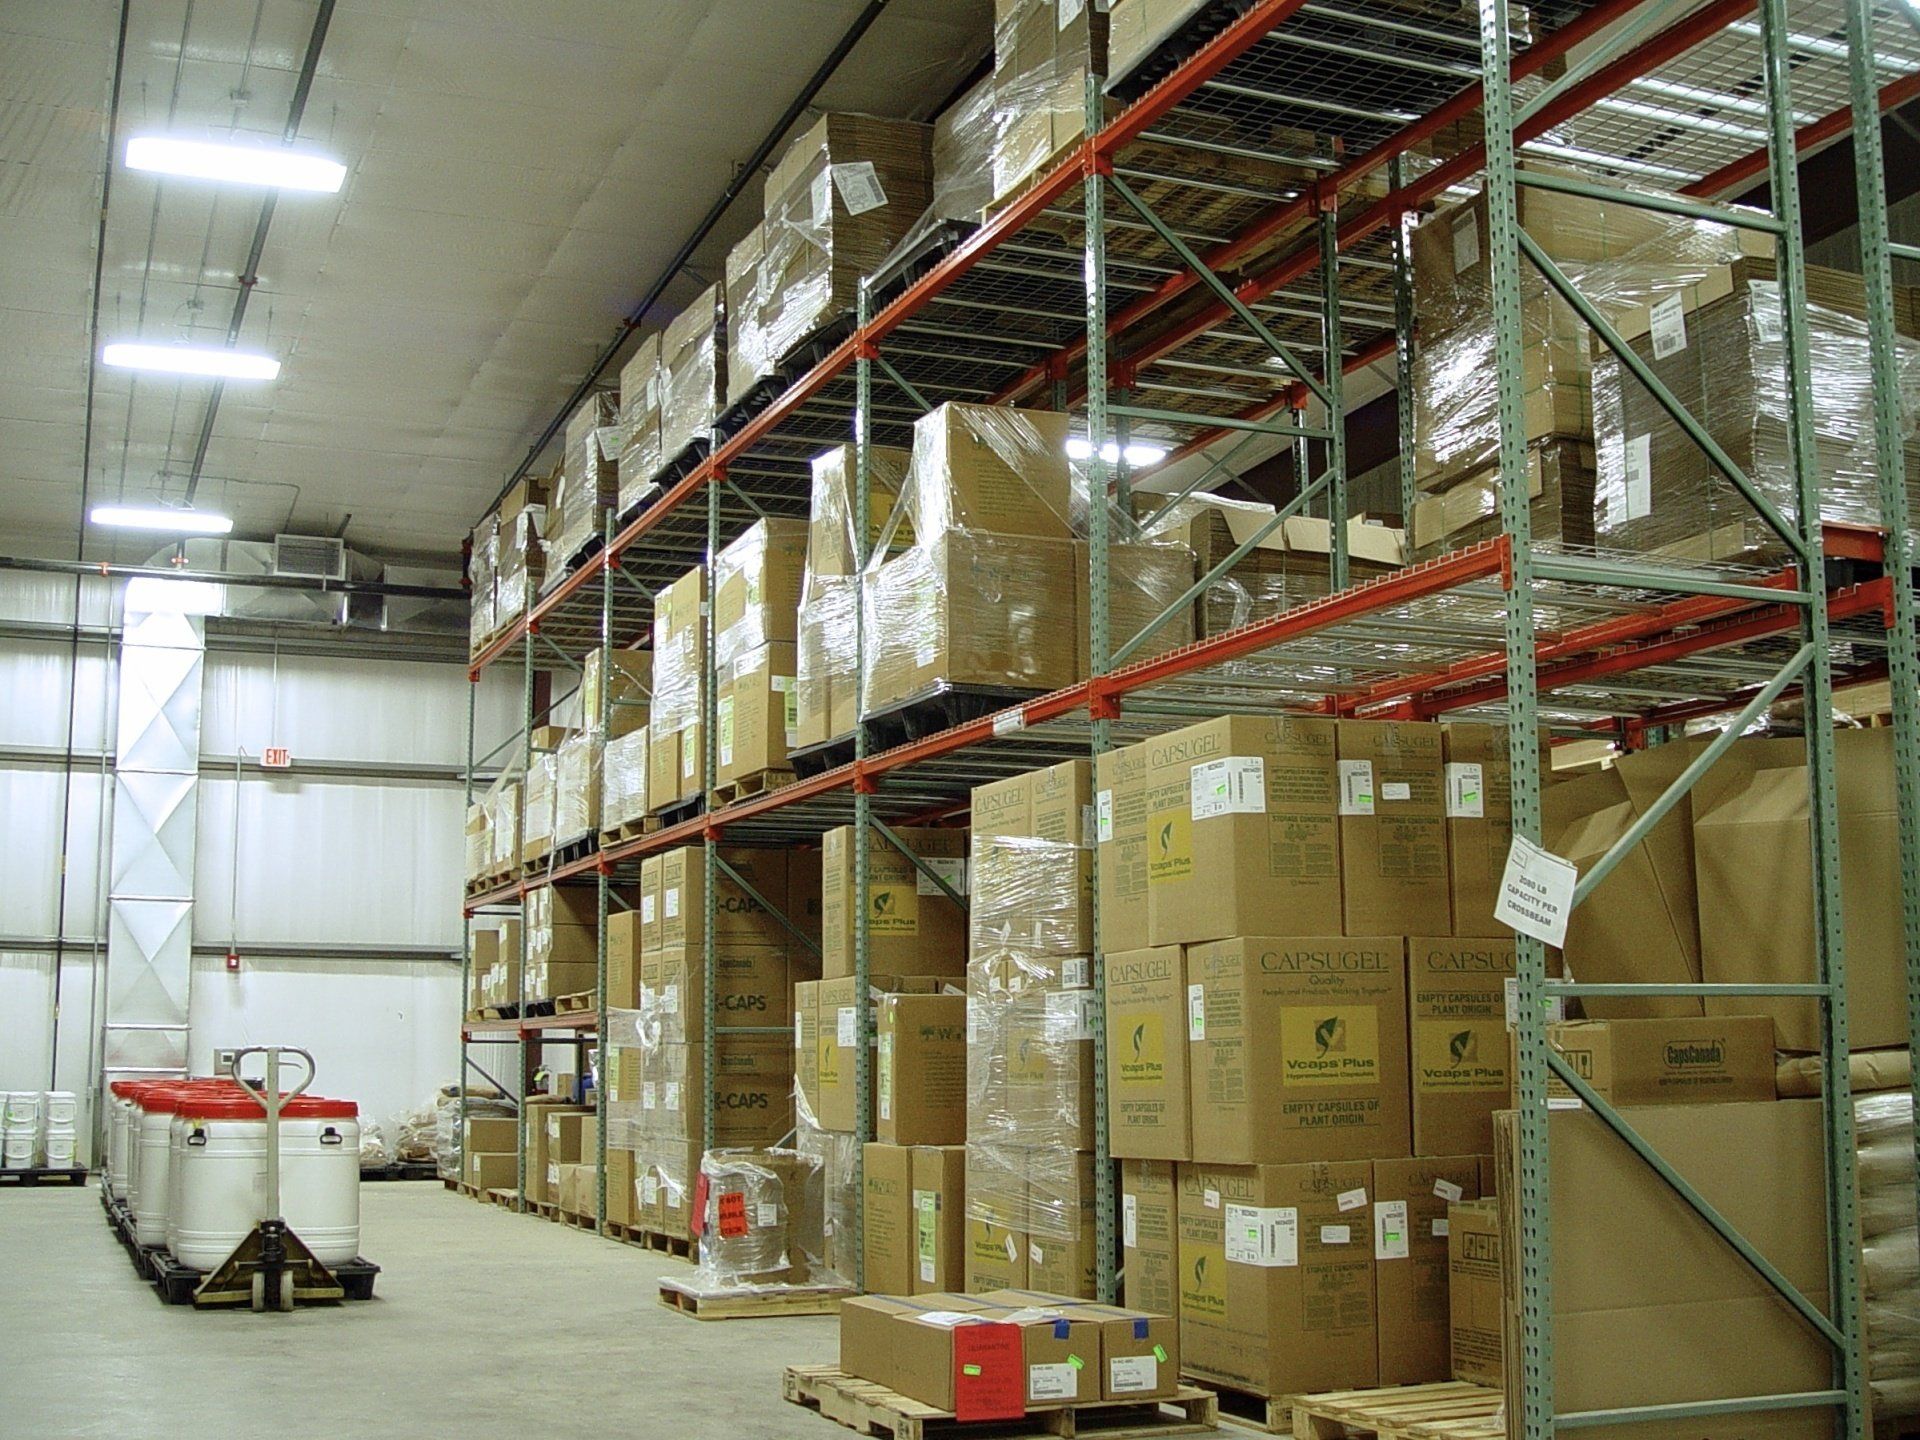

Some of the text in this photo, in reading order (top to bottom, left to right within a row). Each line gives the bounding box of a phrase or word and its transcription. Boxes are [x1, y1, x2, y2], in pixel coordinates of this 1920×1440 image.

[266, 748, 288, 765] EXIT
[1152, 734, 1221, 766] CAPSUGEL
[1174, 857, 1191, 866] Plus
[1537, 884, 1547, 895] LB
[1507, 884, 1558, 915] CAPACITY PER
[1507, 900, 1552, 926] CROSSBEAM
[1261, 951, 1388, 971] CAPSUGEL
[1110, 959, 1171, 982] CAPSUGEL
[1308, 974, 1345, 987] Quality
[1417, 994, 1446, 1003] EMPTY
[1448, 994, 1491, 1003] CAPSULES
[1432, 1005, 1492, 1014] PLANT ORIGIN
[1667, 1043, 1721, 1066] CapsCanada
[1121, 1062, 1163, 1073] Vcaps Plus
[1287, 1058, 1375, 1071] Vcaps Plus
[1423, 1068, 1504, 1079] Vcaps Plus
[1282, 1101, 1379, 1114] EMPTY CAPSULES OF
[1299, 1113, 1364, 1126] PLANT ORIGIN
[1184, 1173, 1254, 1197] CAPSUGEL
[1182, 1289, 1225, 1306] Vcaps Plus
